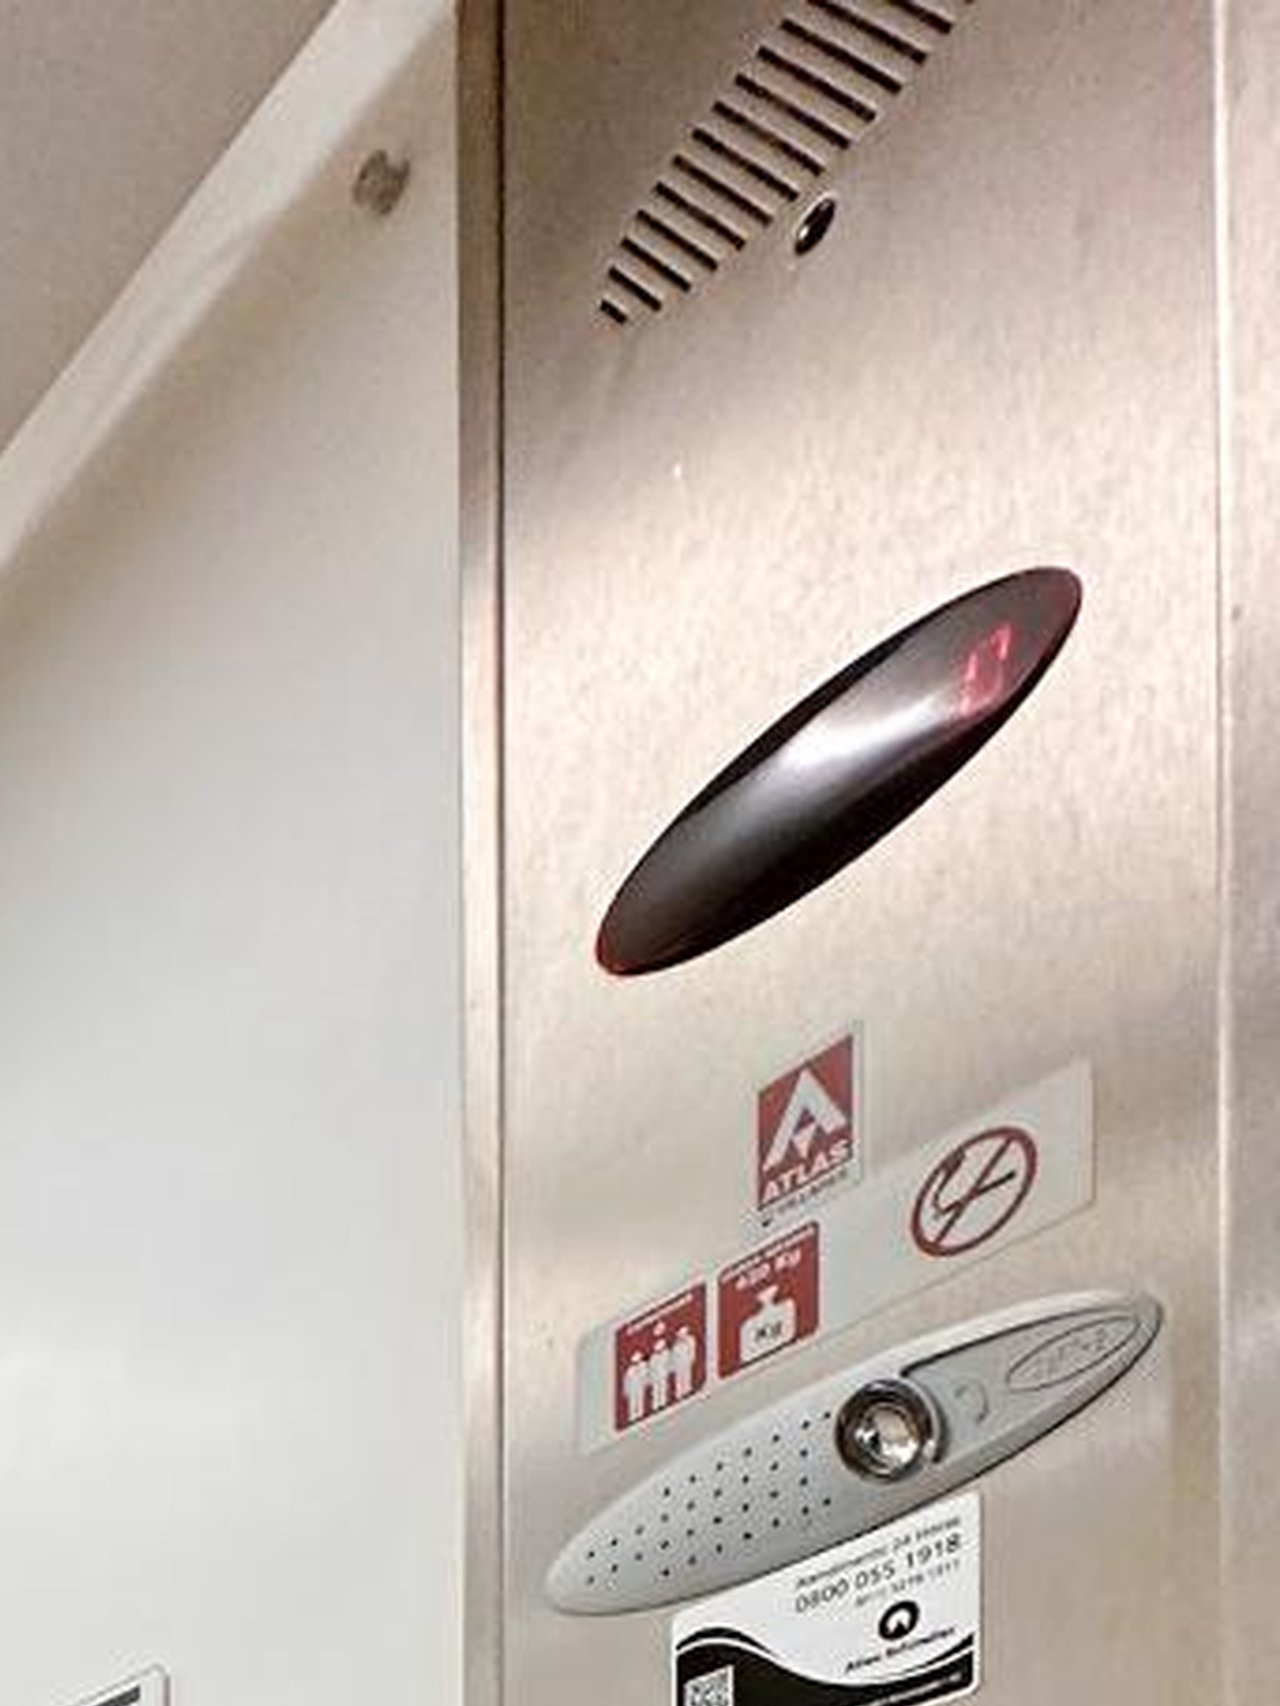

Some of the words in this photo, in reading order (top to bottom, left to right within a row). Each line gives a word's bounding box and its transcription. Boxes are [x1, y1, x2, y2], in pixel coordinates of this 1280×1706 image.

[762, 1139, 852, 1202] ATLAS
[794, 1577, 850, 1614] 0800
[854, 1560, 895, 1590] 055
[906, 1531, 961, 1569] 1918
